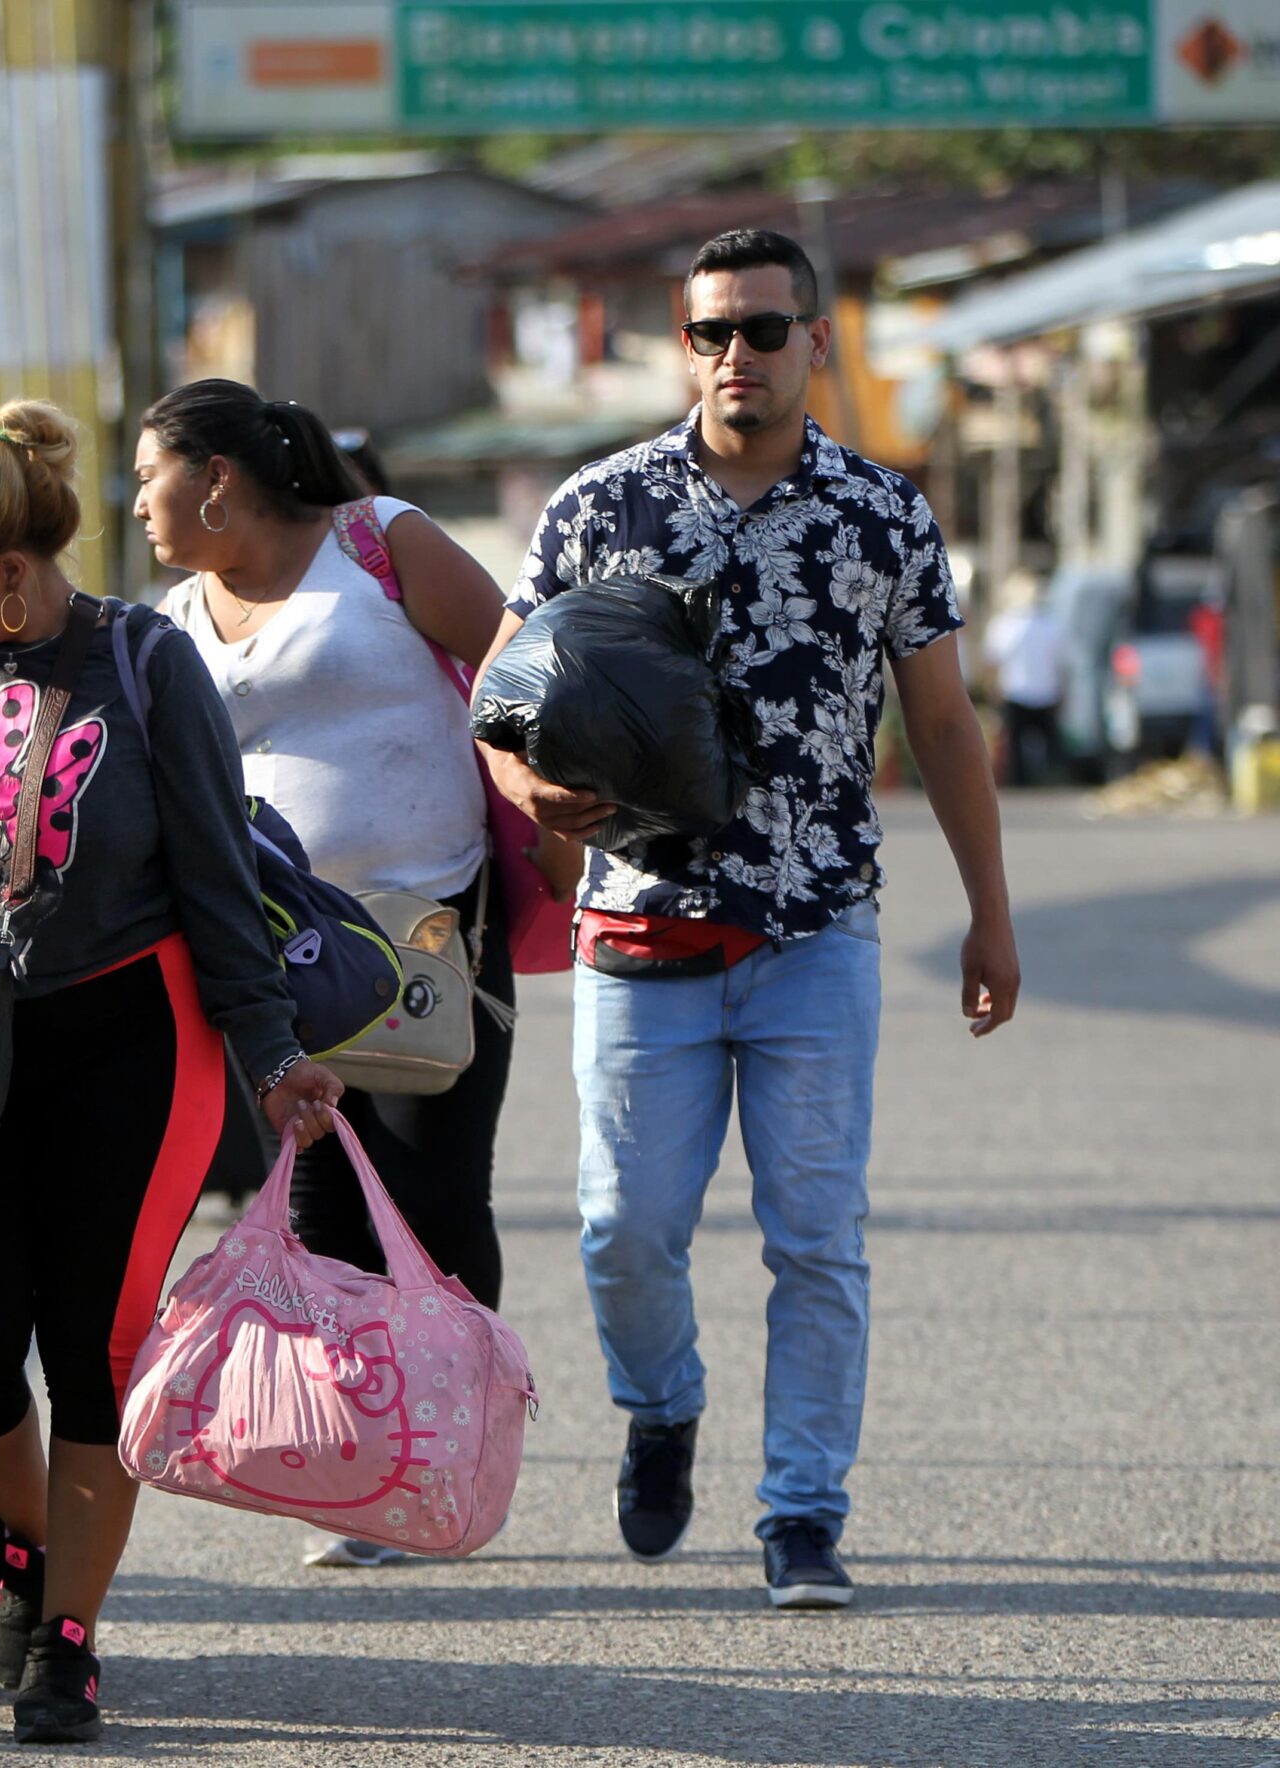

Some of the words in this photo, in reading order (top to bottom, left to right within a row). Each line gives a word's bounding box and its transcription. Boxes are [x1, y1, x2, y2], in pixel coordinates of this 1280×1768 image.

[409, 10, 784, 64] Bienvenidos
[801, 16, 844, 62] a
[859, 3, 1147, 60] Colombia
[887, 66, 970, 103] San
[979, 64, 1127, 116] Miguel
[235, 1258, 294, 1313] Hello
